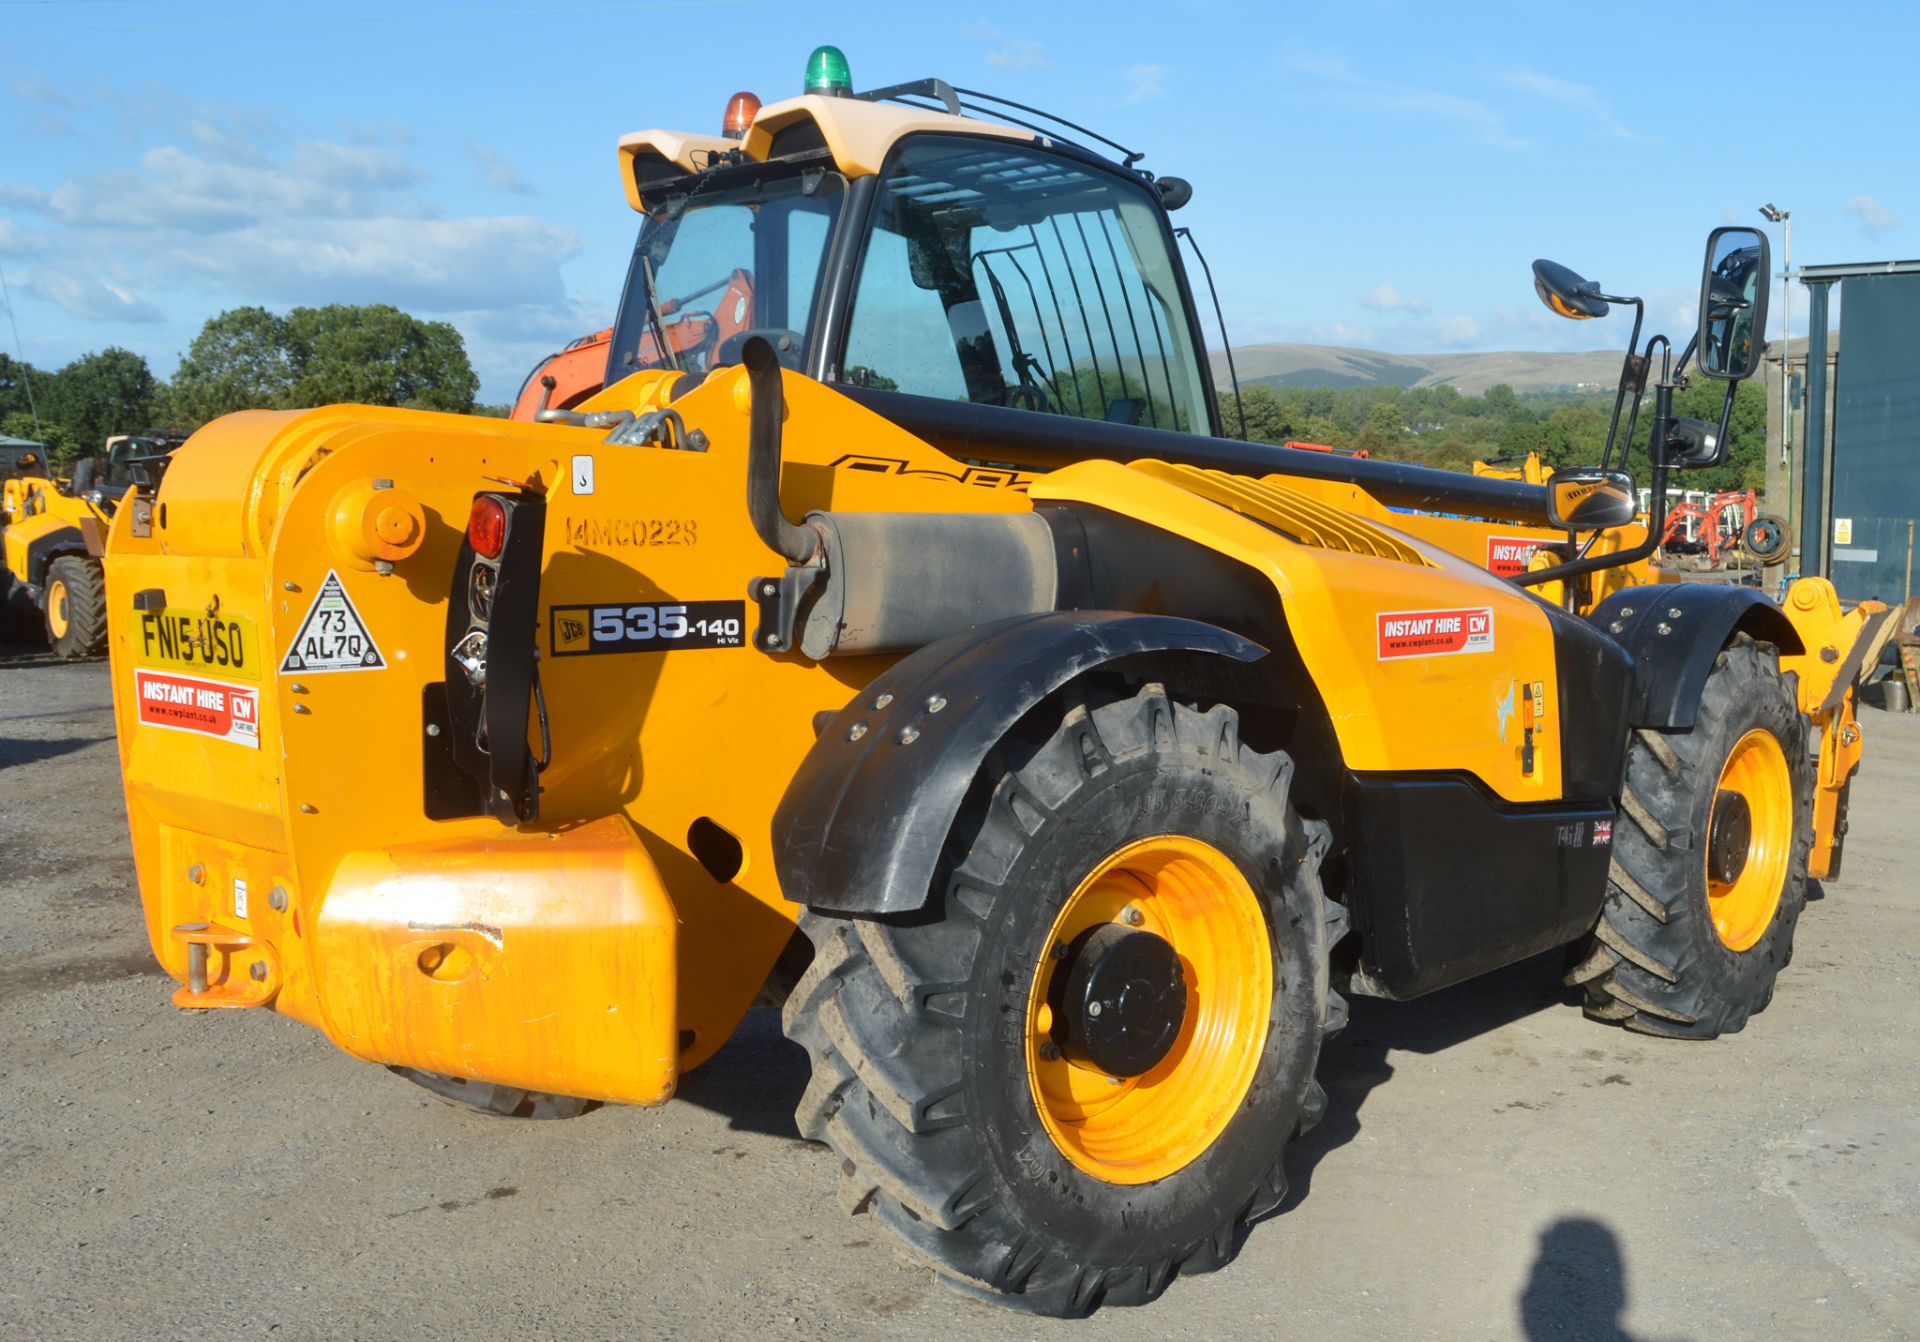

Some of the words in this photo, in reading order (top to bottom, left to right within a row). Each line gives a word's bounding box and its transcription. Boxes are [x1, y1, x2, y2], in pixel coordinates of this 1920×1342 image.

[319, 610, 346, 633] 73
[563, 620, 584, 641] JCB
[592, 605, 740, 642] 535-140
[1385, 619, 1434, 637] INSTANT
[1435, 617, 1462, 633] HIRE
[1469, 616, 1486, 633] CW
[306, 635, 361, 659] AL7Q
[717, 637, 726, 645] Hi
[1390, 636, 1453, 649] www.cwplant.co.uk
[143, 680, 195, 706] INSTANT
[197, 688, 225, 712] HIRE
[149, 705, 217, 724] www.cwplant.co.uk
[232, 697, 251, 719] CW
